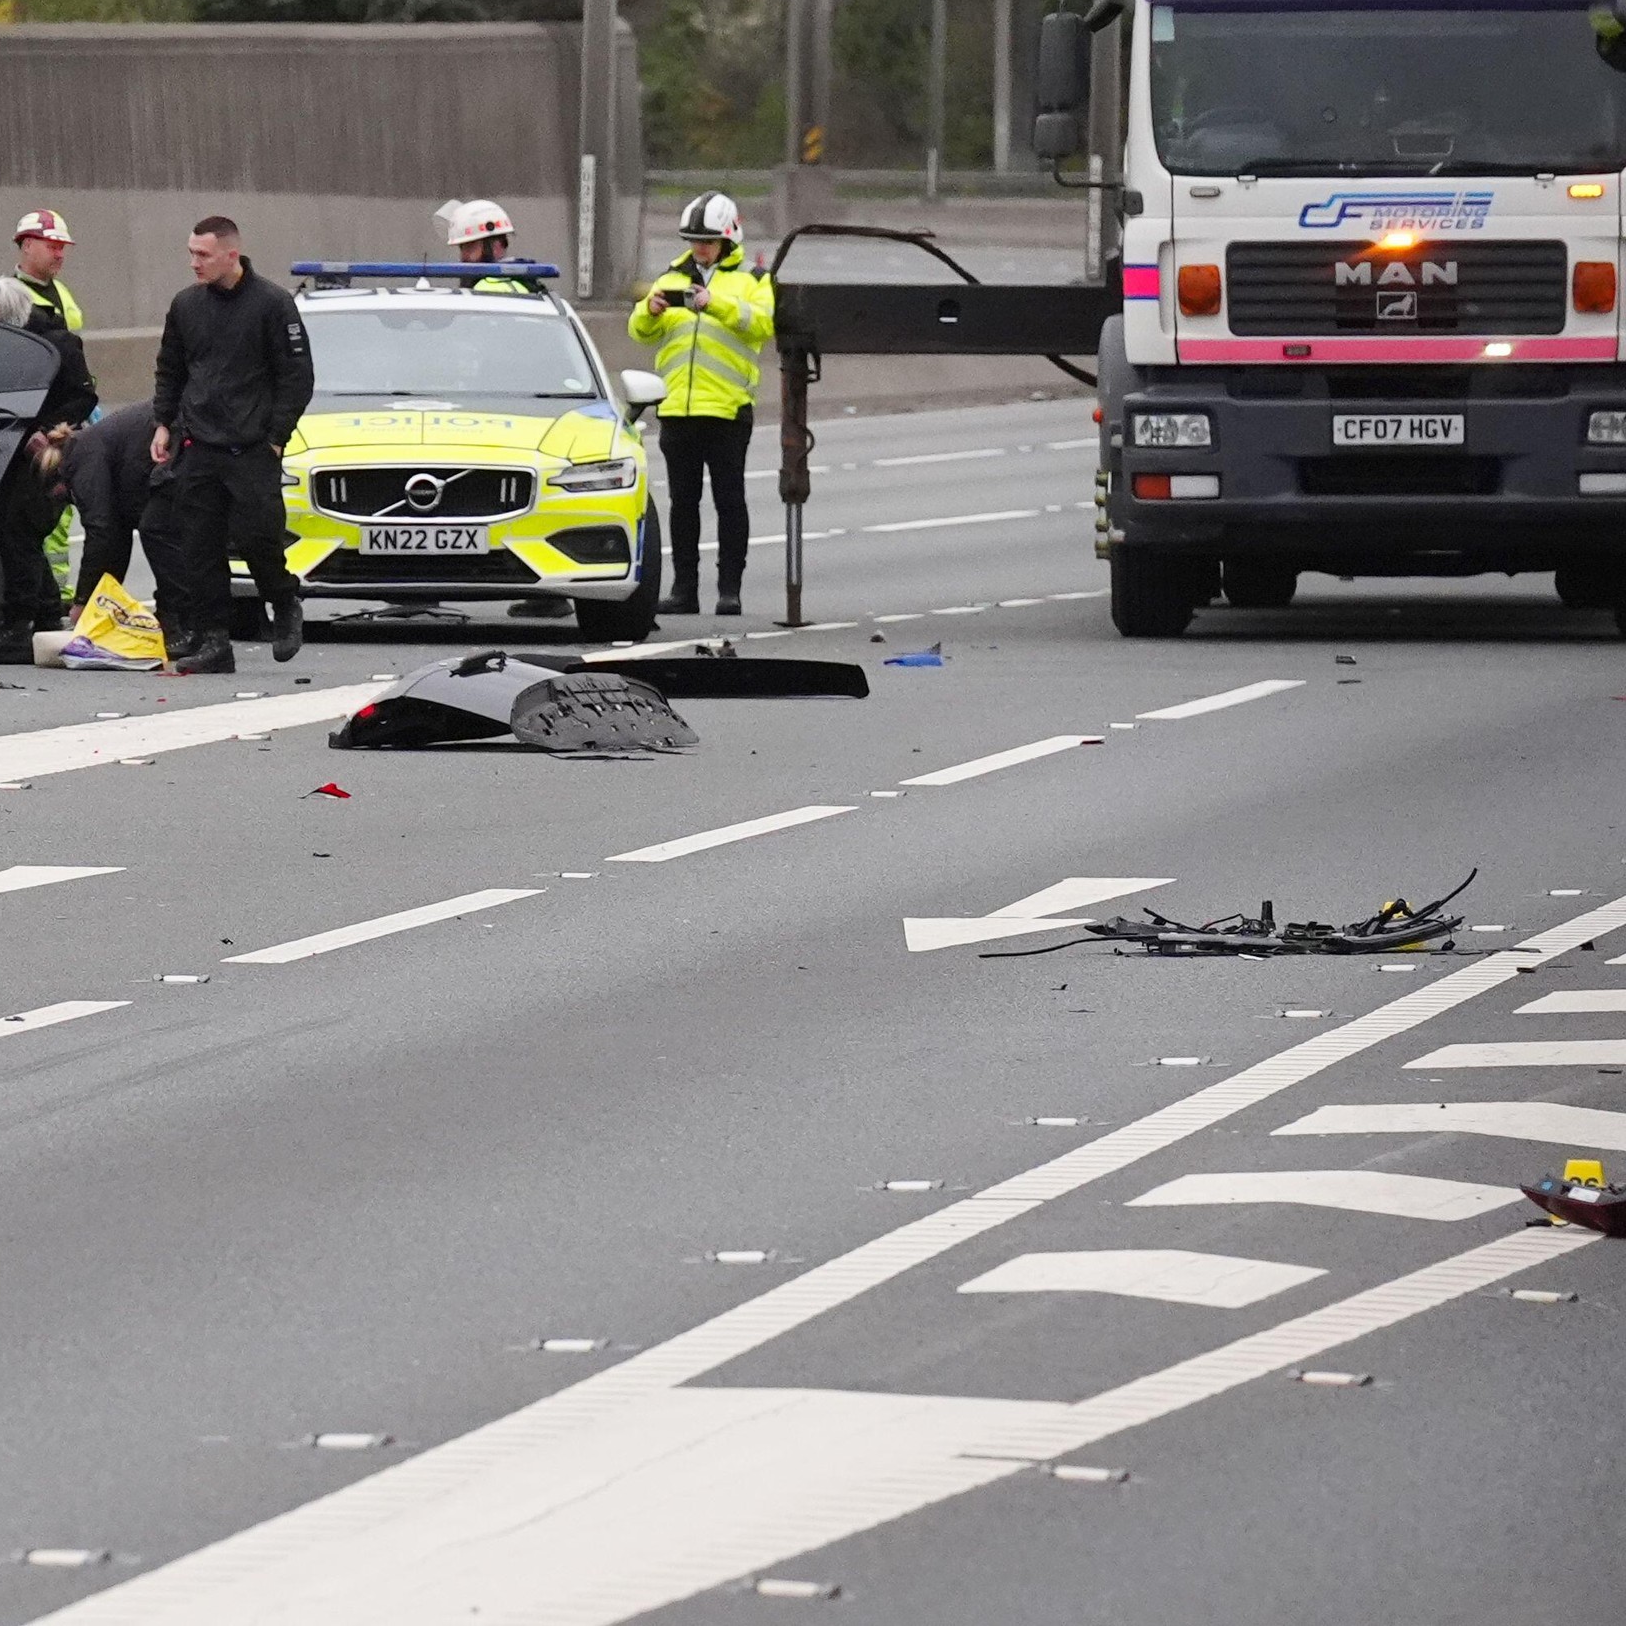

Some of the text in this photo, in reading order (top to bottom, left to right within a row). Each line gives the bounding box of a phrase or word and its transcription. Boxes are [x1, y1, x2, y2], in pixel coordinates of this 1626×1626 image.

[1369, 218, 1485, 230] SERVICES
[1334, 261, 1458, 286] MAN
[1344, 418, 1453, 440] CF07 HGV
[369, 529, 478, 550] KN22 GZX
